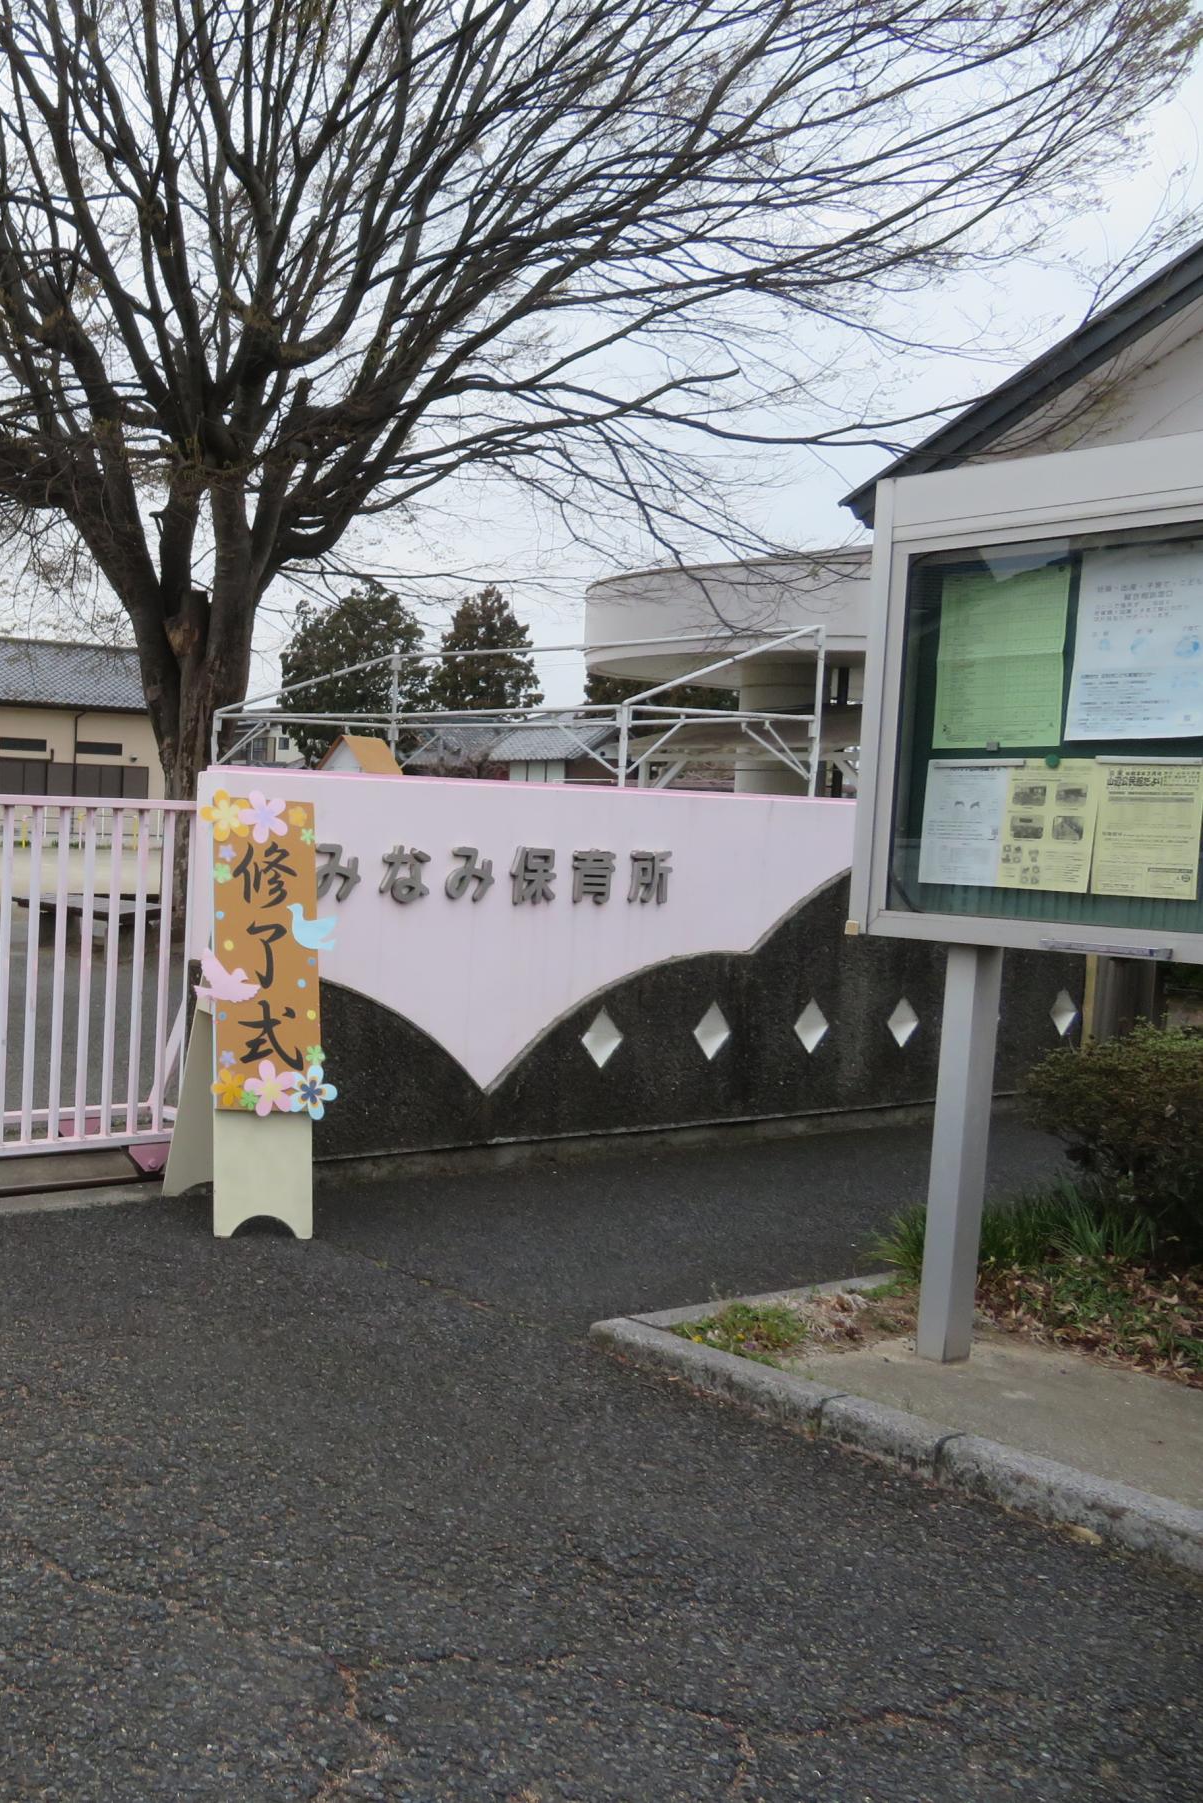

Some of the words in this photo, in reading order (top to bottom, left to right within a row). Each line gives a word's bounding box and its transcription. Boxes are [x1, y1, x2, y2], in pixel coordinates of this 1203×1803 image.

[316, 843, 674, 905] みなみ保育所
[233, 841, 304, 1072] 修了式
